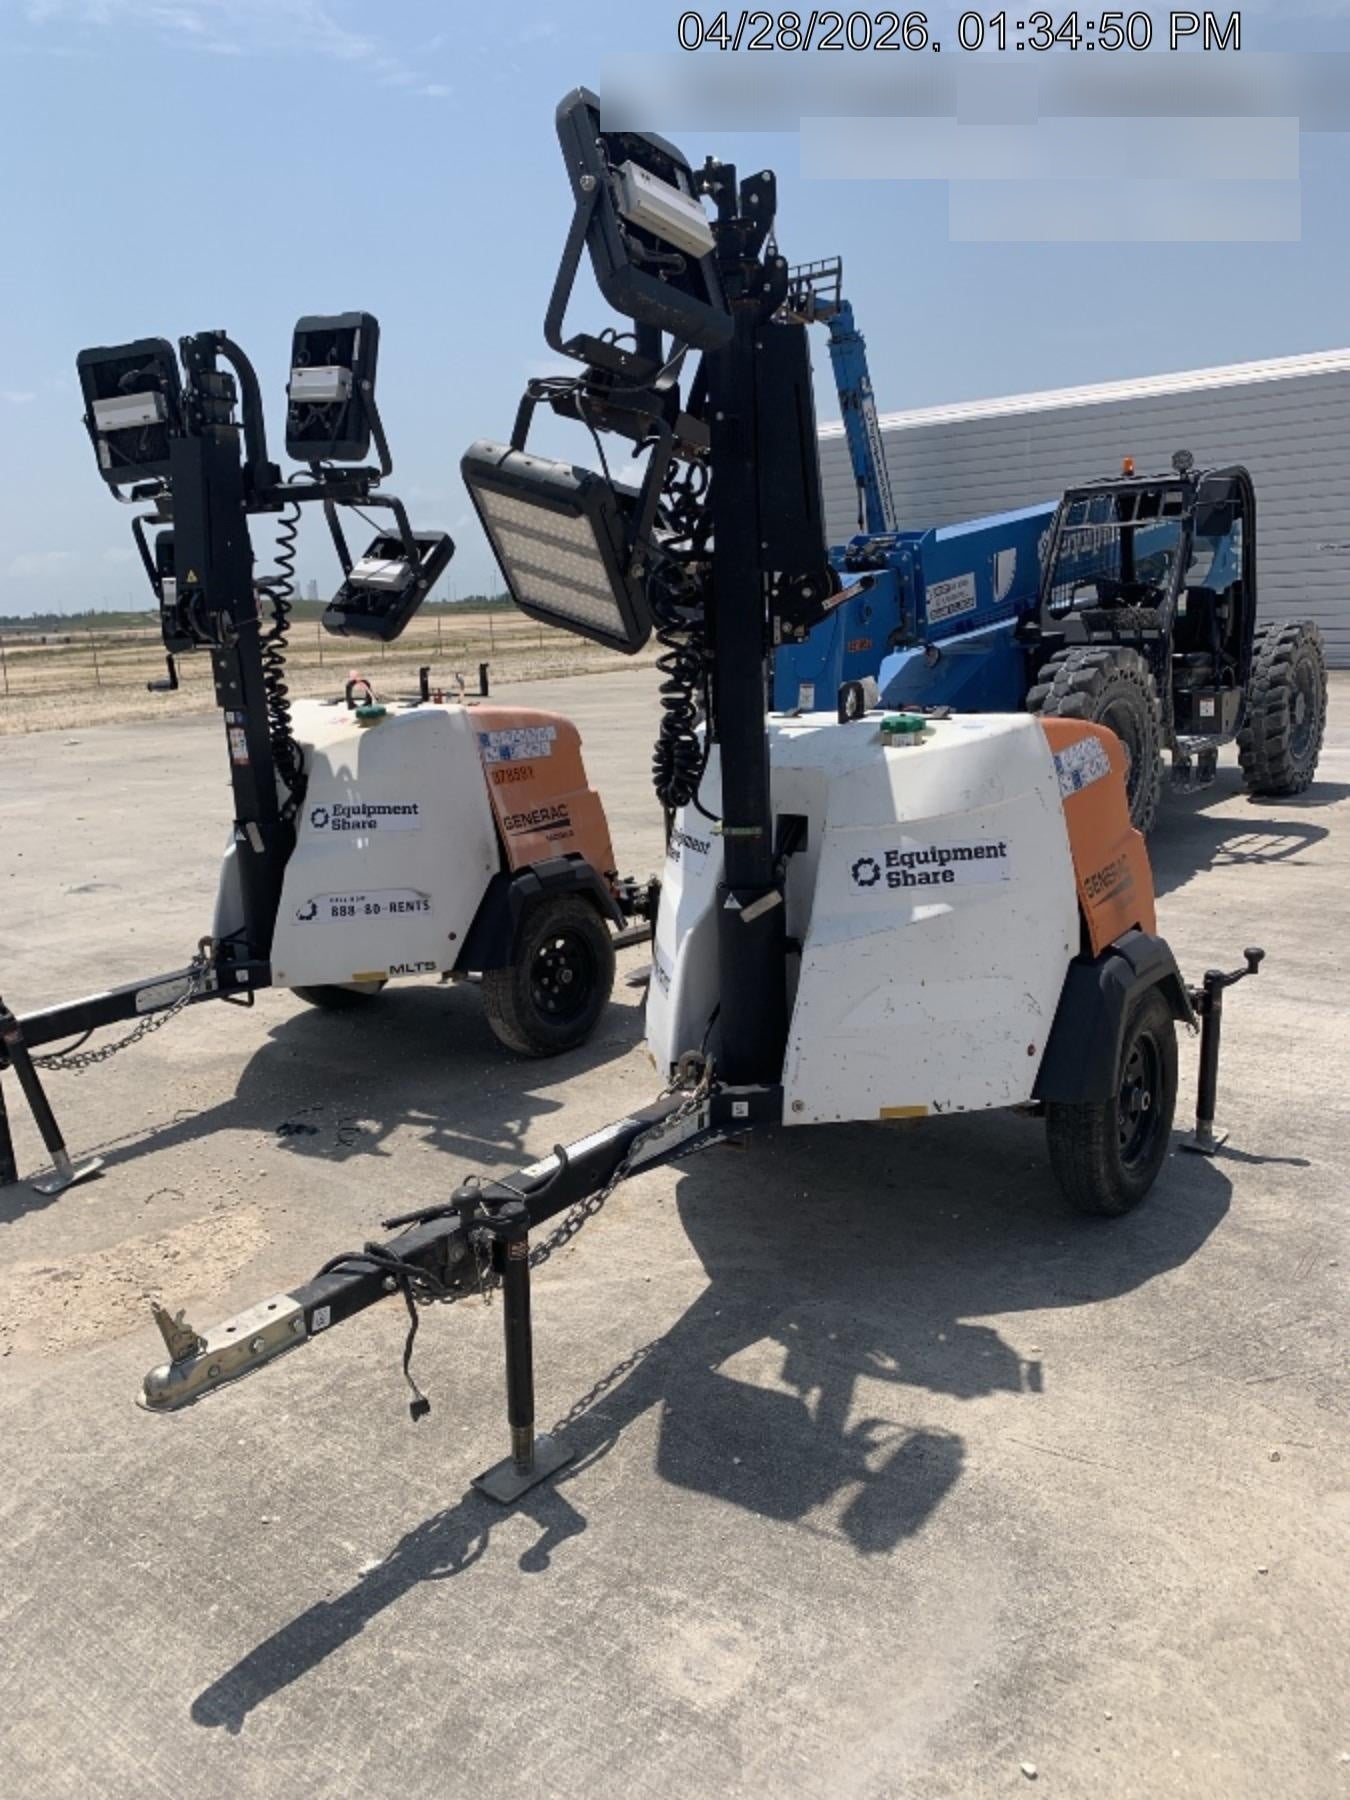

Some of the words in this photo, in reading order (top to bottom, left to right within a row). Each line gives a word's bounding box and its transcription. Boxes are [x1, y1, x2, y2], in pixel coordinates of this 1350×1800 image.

[332, 804, 419, 818] Equipment
[504, 803, 569, 830] GENERAC
[332, 818, 377, 831] Share
[884, 841, 1007, 869] Equipment
[886, 869, 955, 888] Share
